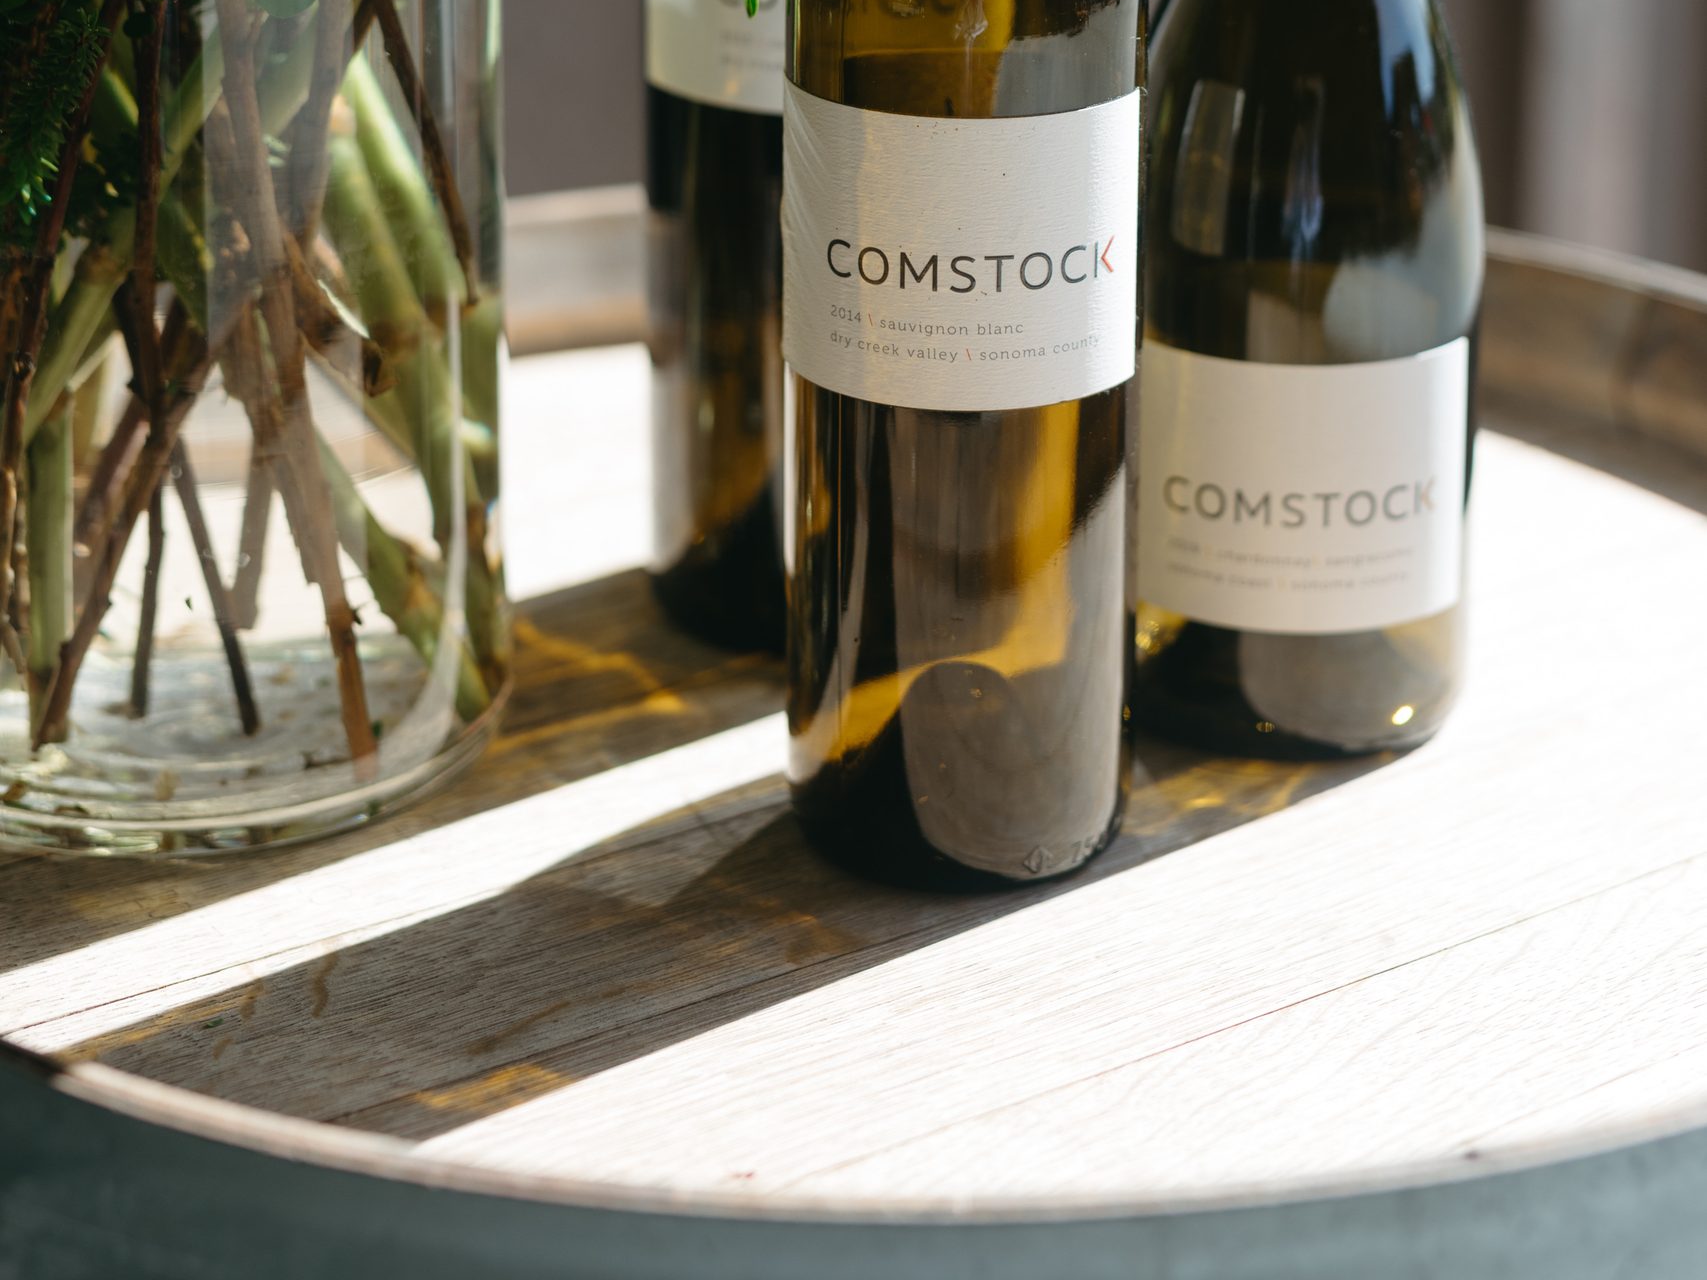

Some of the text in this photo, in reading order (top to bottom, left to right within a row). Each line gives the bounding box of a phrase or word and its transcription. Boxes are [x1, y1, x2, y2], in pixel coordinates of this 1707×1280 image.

[827, 234, 1116, 294] COMSTOCK
[830, 304, 863, 324] 2014
[879, 318, 969, 337] sauvignon
[976, 320, 1025, 336] blanc
[830, 330, 852, 349] dry
[857, 337, 900, 357] creek
[906, 345, 958, 364] valley
[979, 345, 1047, 362] sonoma
[1052, 333, 1101, 355] county
[1162, 474, 1438, 529] COMSTOCK
